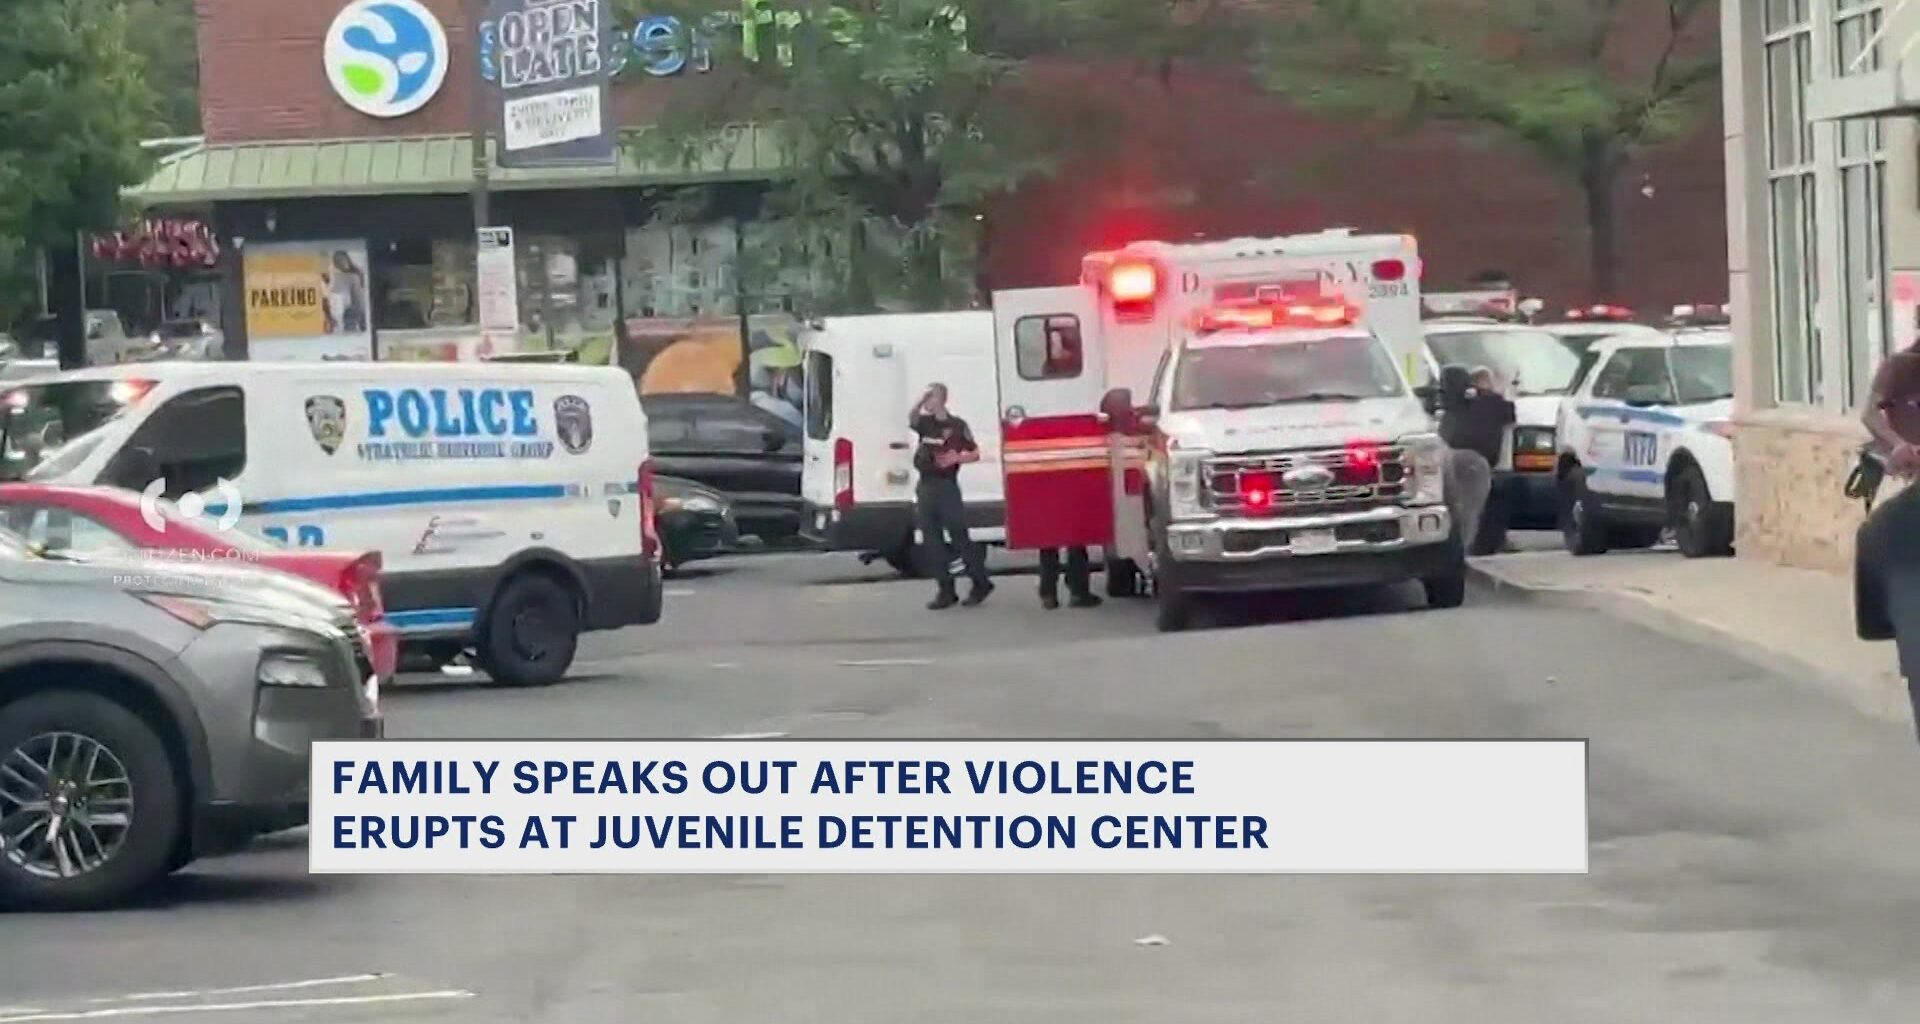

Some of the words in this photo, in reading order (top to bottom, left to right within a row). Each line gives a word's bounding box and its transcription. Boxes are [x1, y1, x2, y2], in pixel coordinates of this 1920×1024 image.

[502, 35, 600, 88] LATE
[251, 288, 317, 307] PARKING
[364, 389, 538, 437] POLICE
